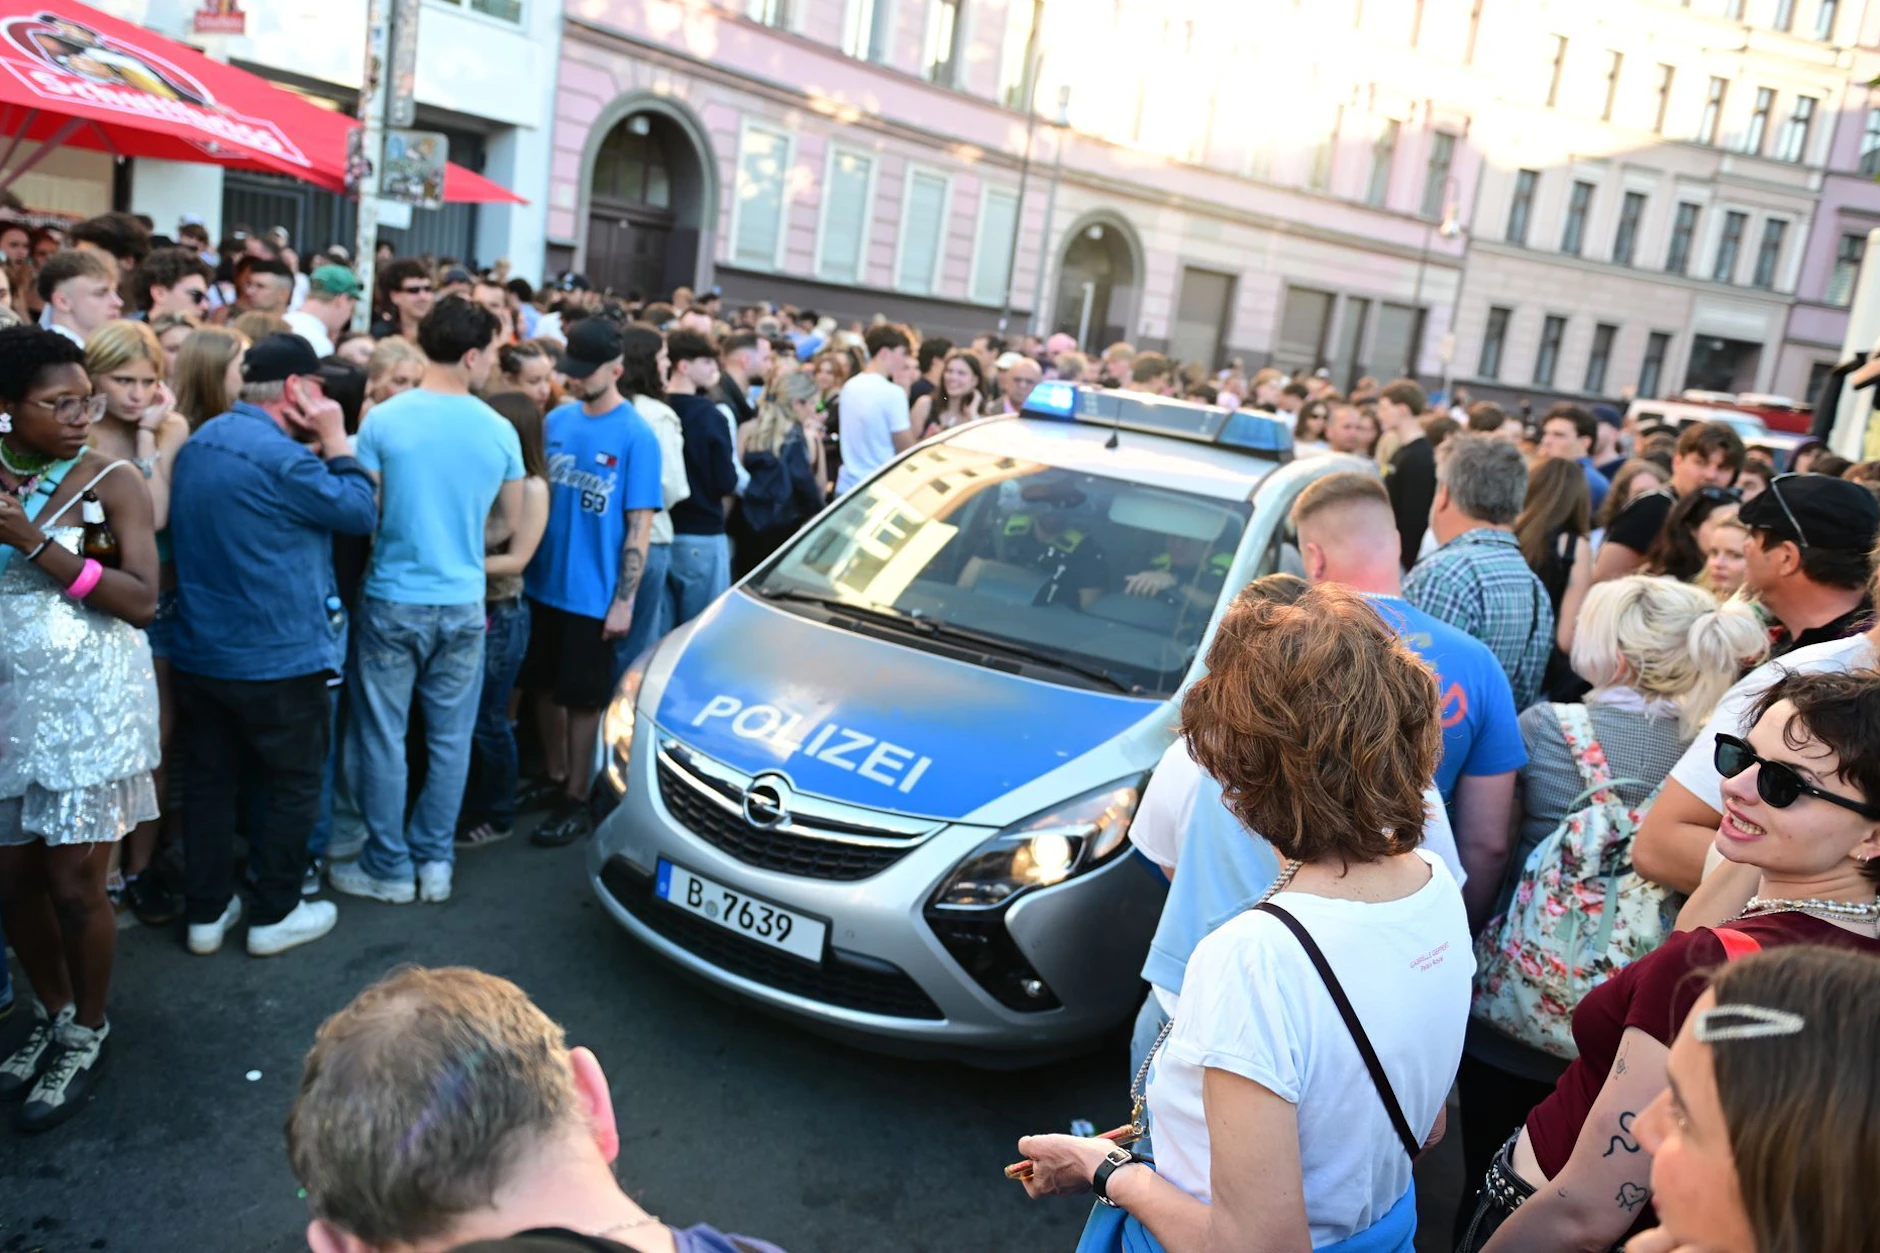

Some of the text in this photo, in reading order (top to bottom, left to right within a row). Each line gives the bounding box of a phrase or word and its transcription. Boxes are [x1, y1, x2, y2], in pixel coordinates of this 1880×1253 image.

[691, 695, 933, 793] POLIZEI
[687, 876, 792, 942] B 7639
